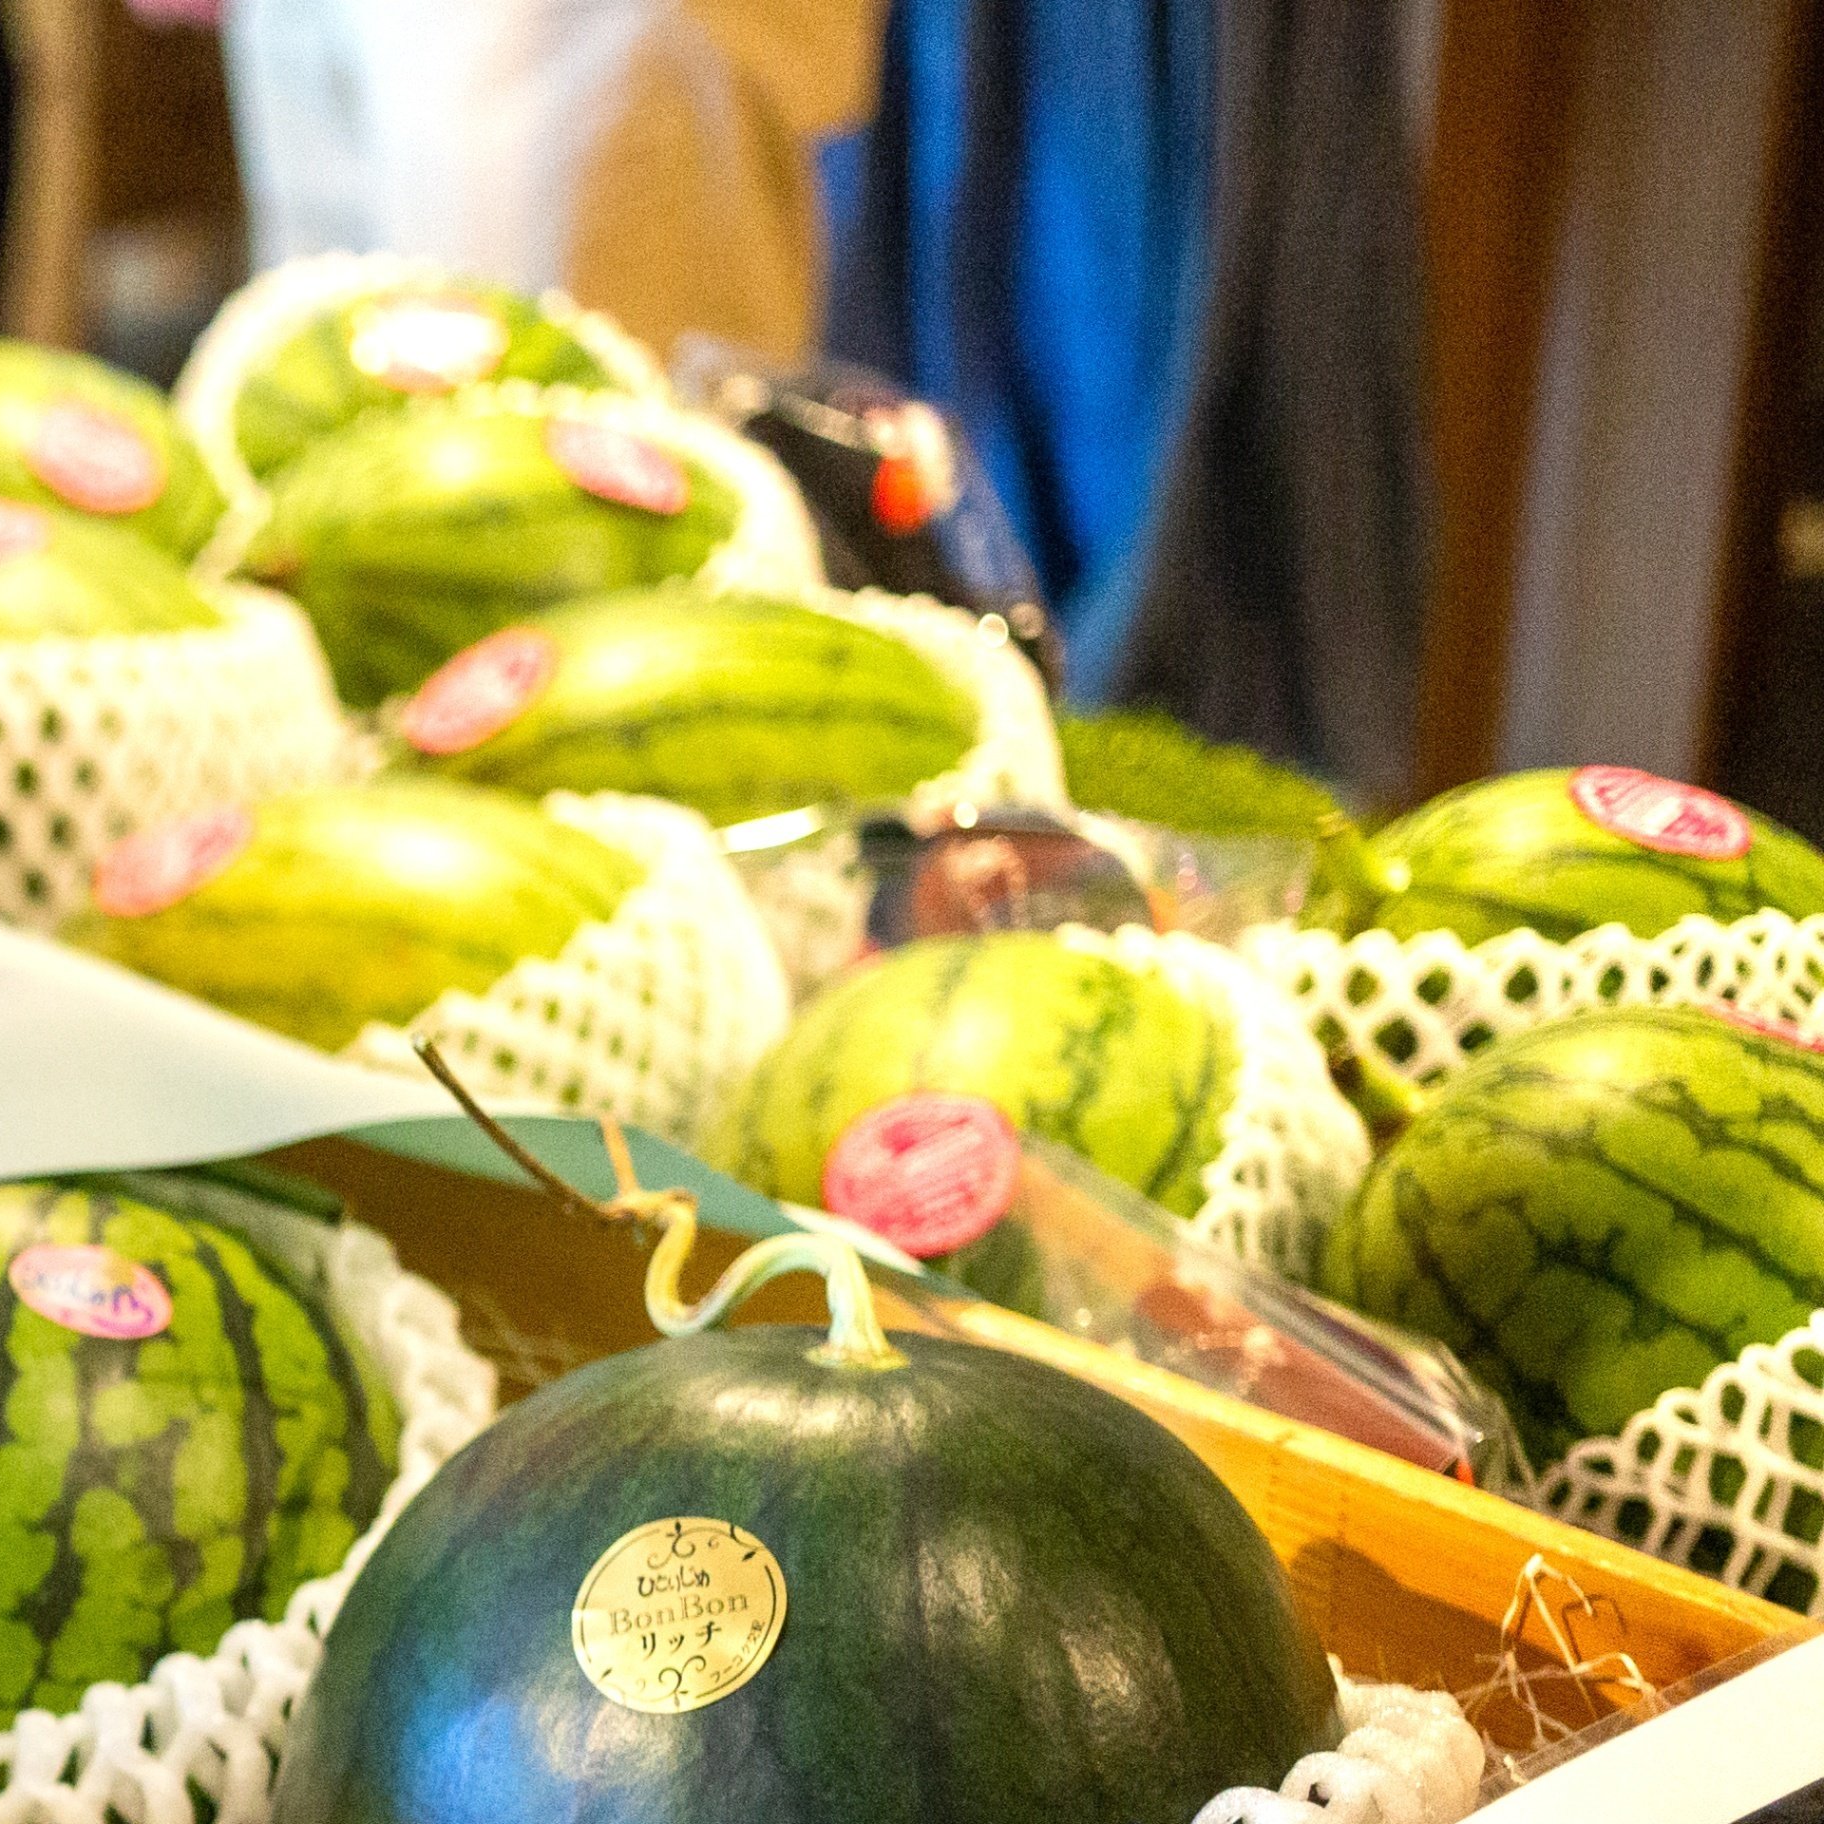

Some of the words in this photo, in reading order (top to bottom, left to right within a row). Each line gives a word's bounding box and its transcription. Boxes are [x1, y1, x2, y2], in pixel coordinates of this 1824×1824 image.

[609, 1592, 750, 1636] BonBon
[641, 1621, 723, 1661] リッチ
